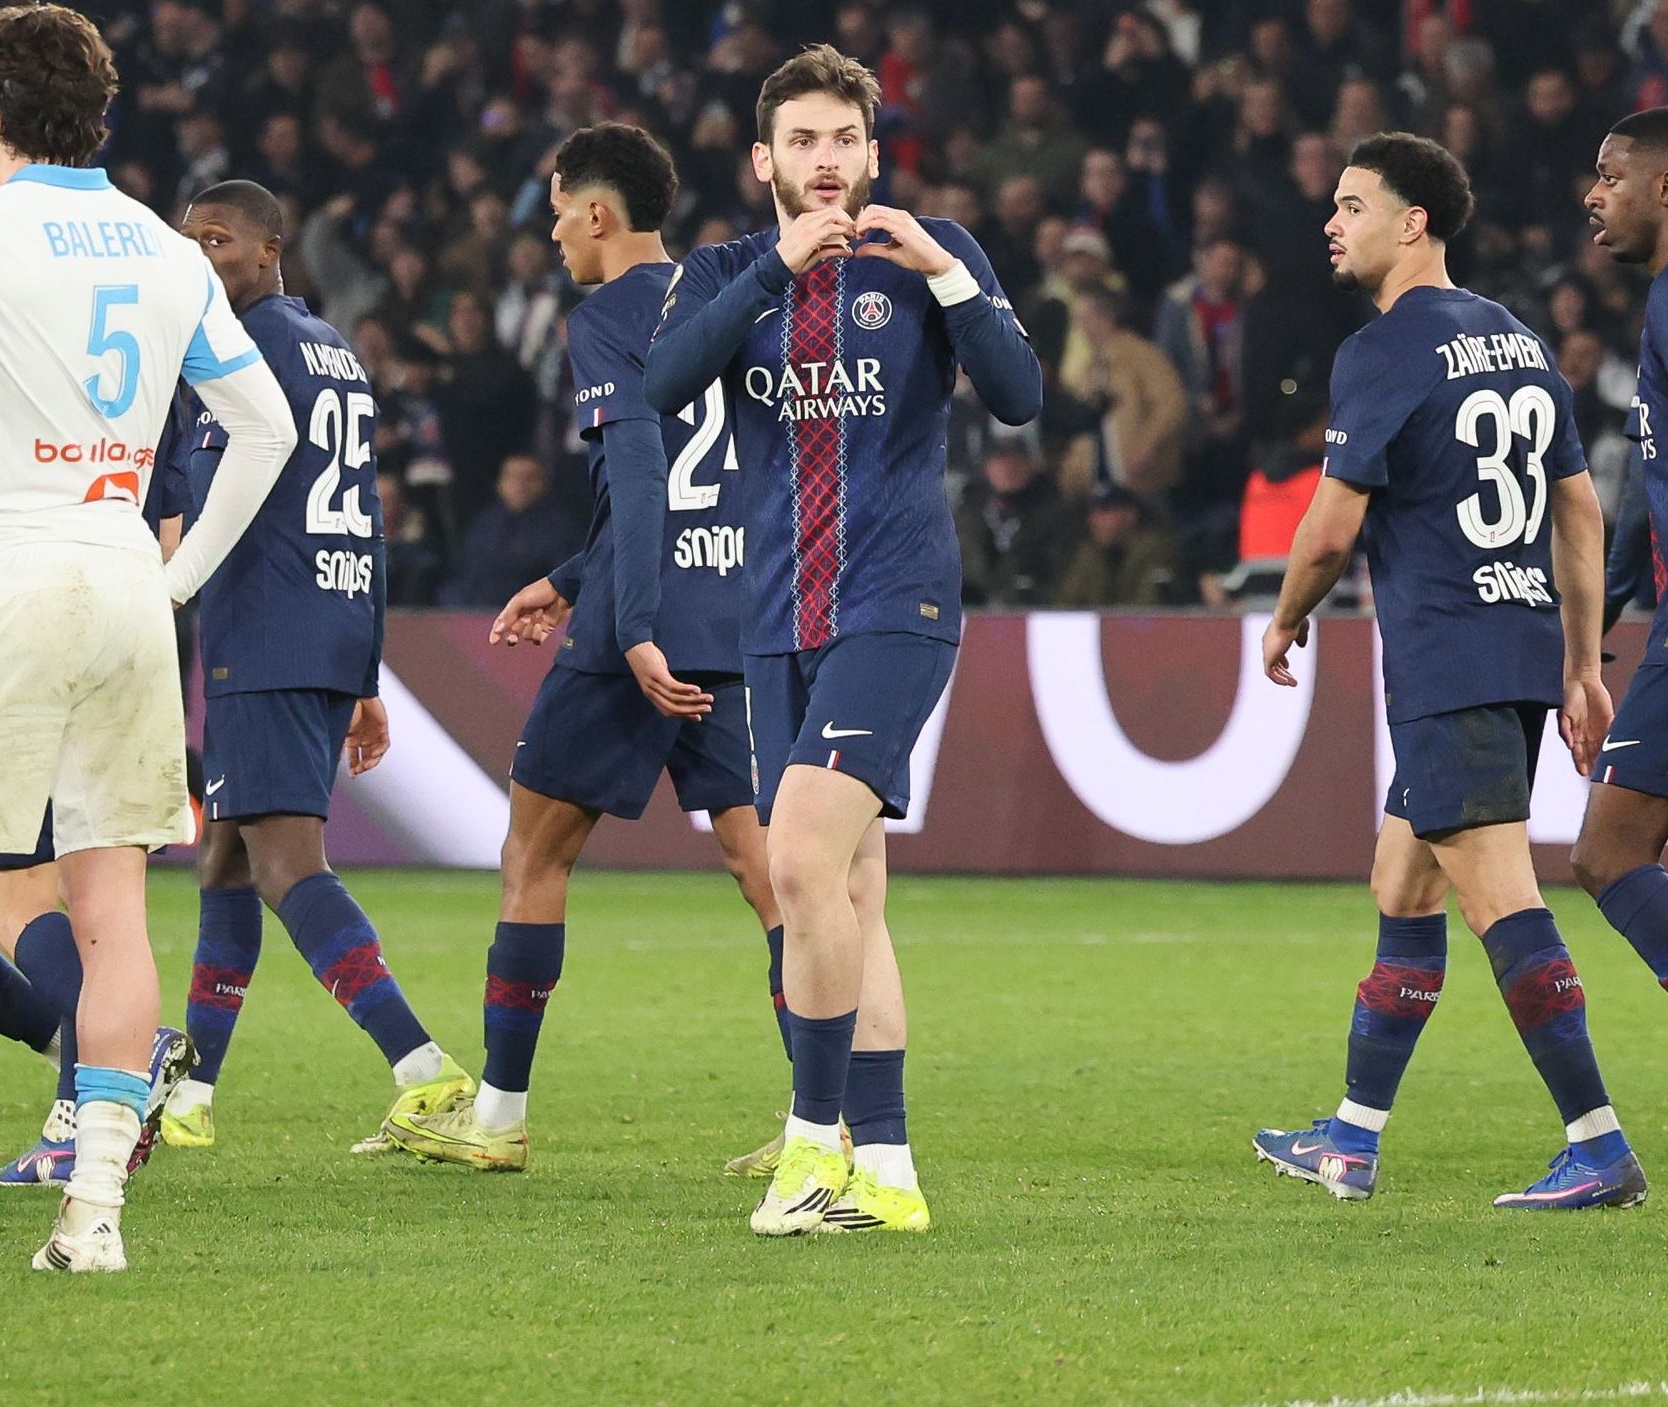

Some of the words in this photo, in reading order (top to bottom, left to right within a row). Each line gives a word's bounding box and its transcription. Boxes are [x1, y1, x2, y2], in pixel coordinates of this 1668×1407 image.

[83, 284, 141, 419] 5
[745, 358, 885, 407] QATAR
[777, 394, 886, 422] AIRWAYS
[305, 388, 374, 538] 25
[1455, 385, 1556, 549] 33
